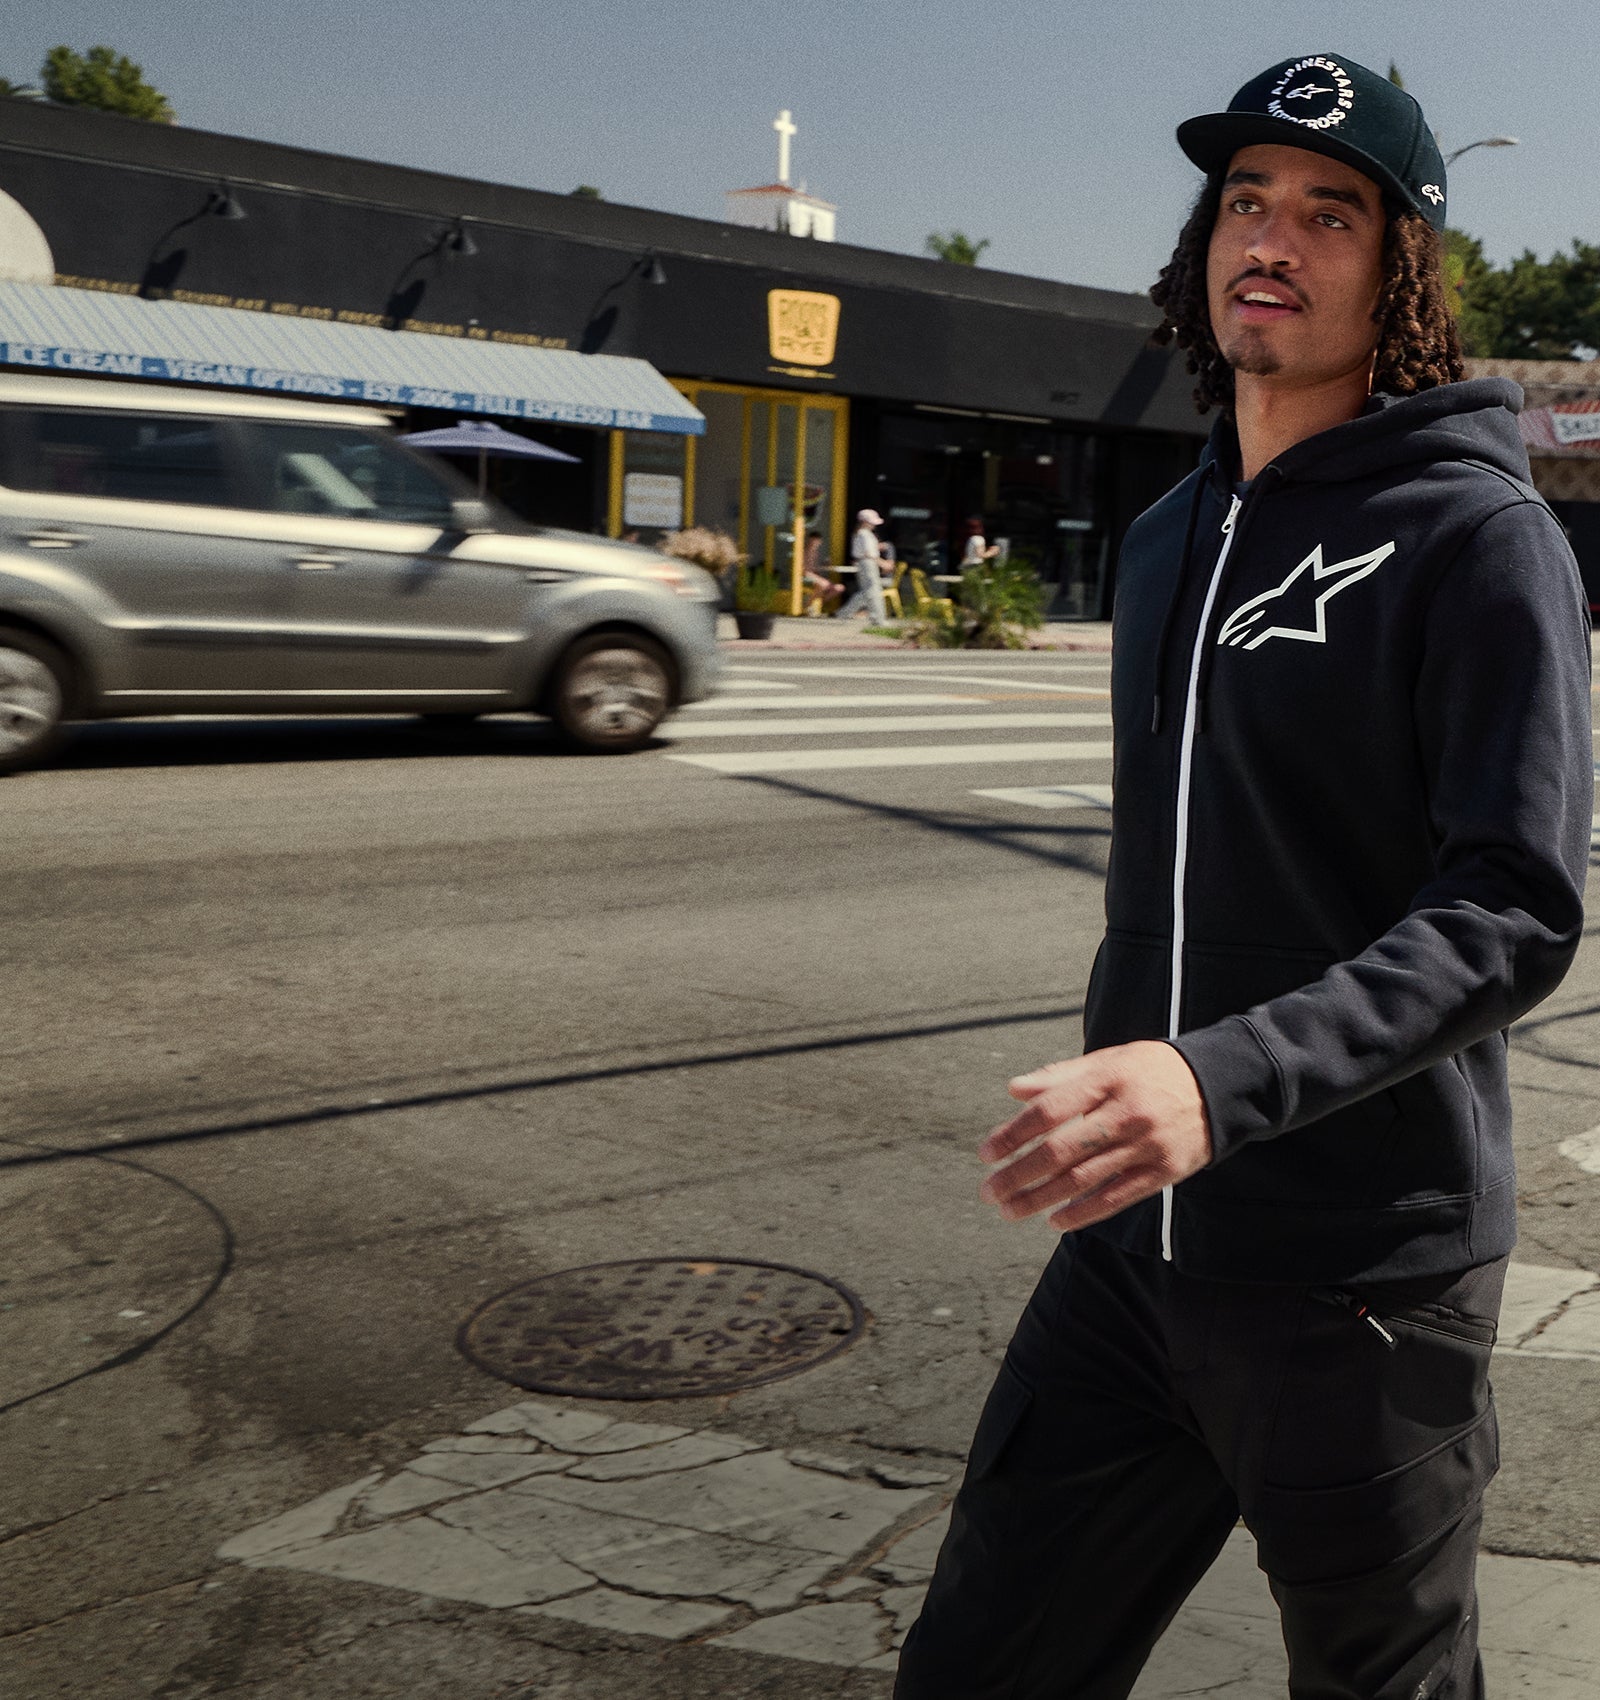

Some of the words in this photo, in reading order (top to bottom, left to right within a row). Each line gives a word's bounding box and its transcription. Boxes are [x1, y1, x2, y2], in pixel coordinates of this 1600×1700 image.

[1271, 56, 1354, 110] ALPINESTARS
[779, 336, 826, 357] RYE
[8, 343, 49, 367] ICE
[53, 347, 142, 375] CREAM
[166, 358, 247, 387] VEGAN
[250, 367, 345, 397] OPTIONS
[524, 400, 612, 428] ESPRESSO
[615, 410, 651, 430] BAR
